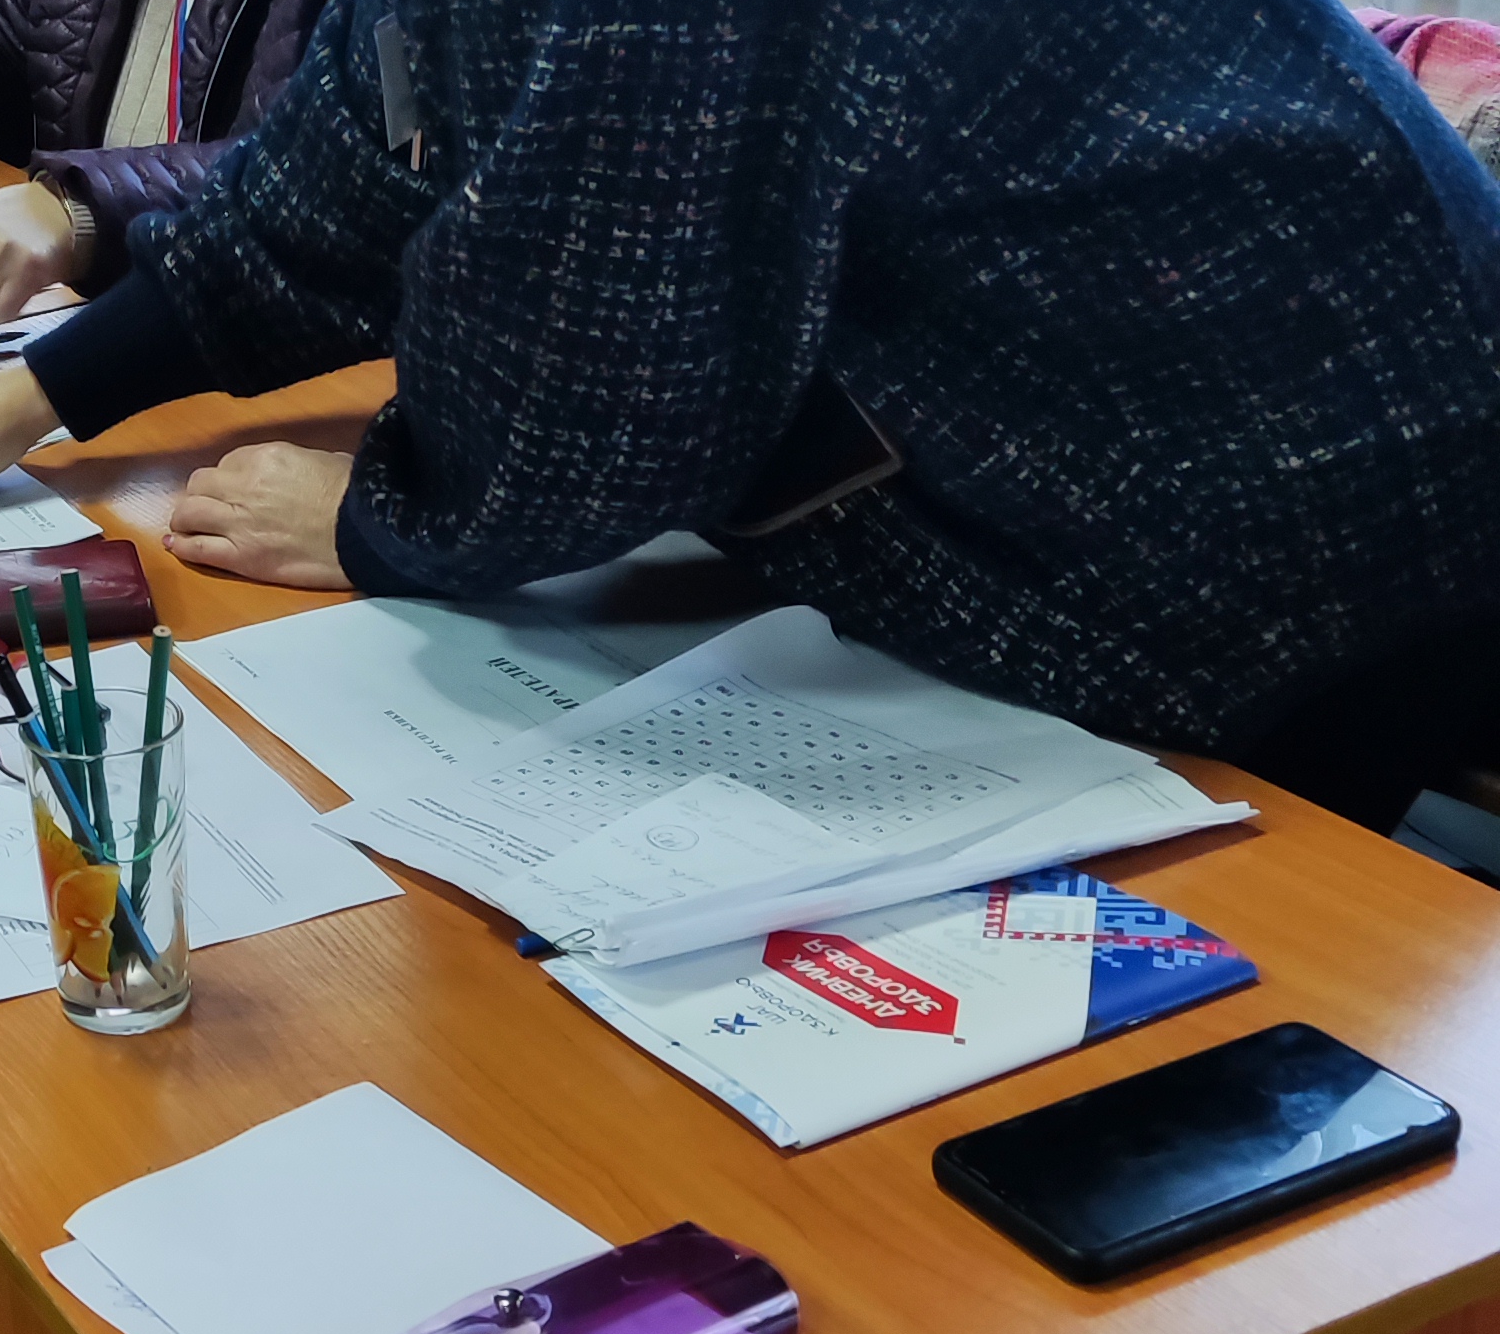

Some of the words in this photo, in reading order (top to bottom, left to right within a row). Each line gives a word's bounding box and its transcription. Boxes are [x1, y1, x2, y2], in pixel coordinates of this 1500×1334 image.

[735, 977, 827, 1029] ЗДОРОВЬЮ
[781, 952, 907, 1019] ДНЕВНИК
[802, 937, 943, 1017] ЗДОРОВЬЯ
[746, 1004, 788, 1025] ШАГ
